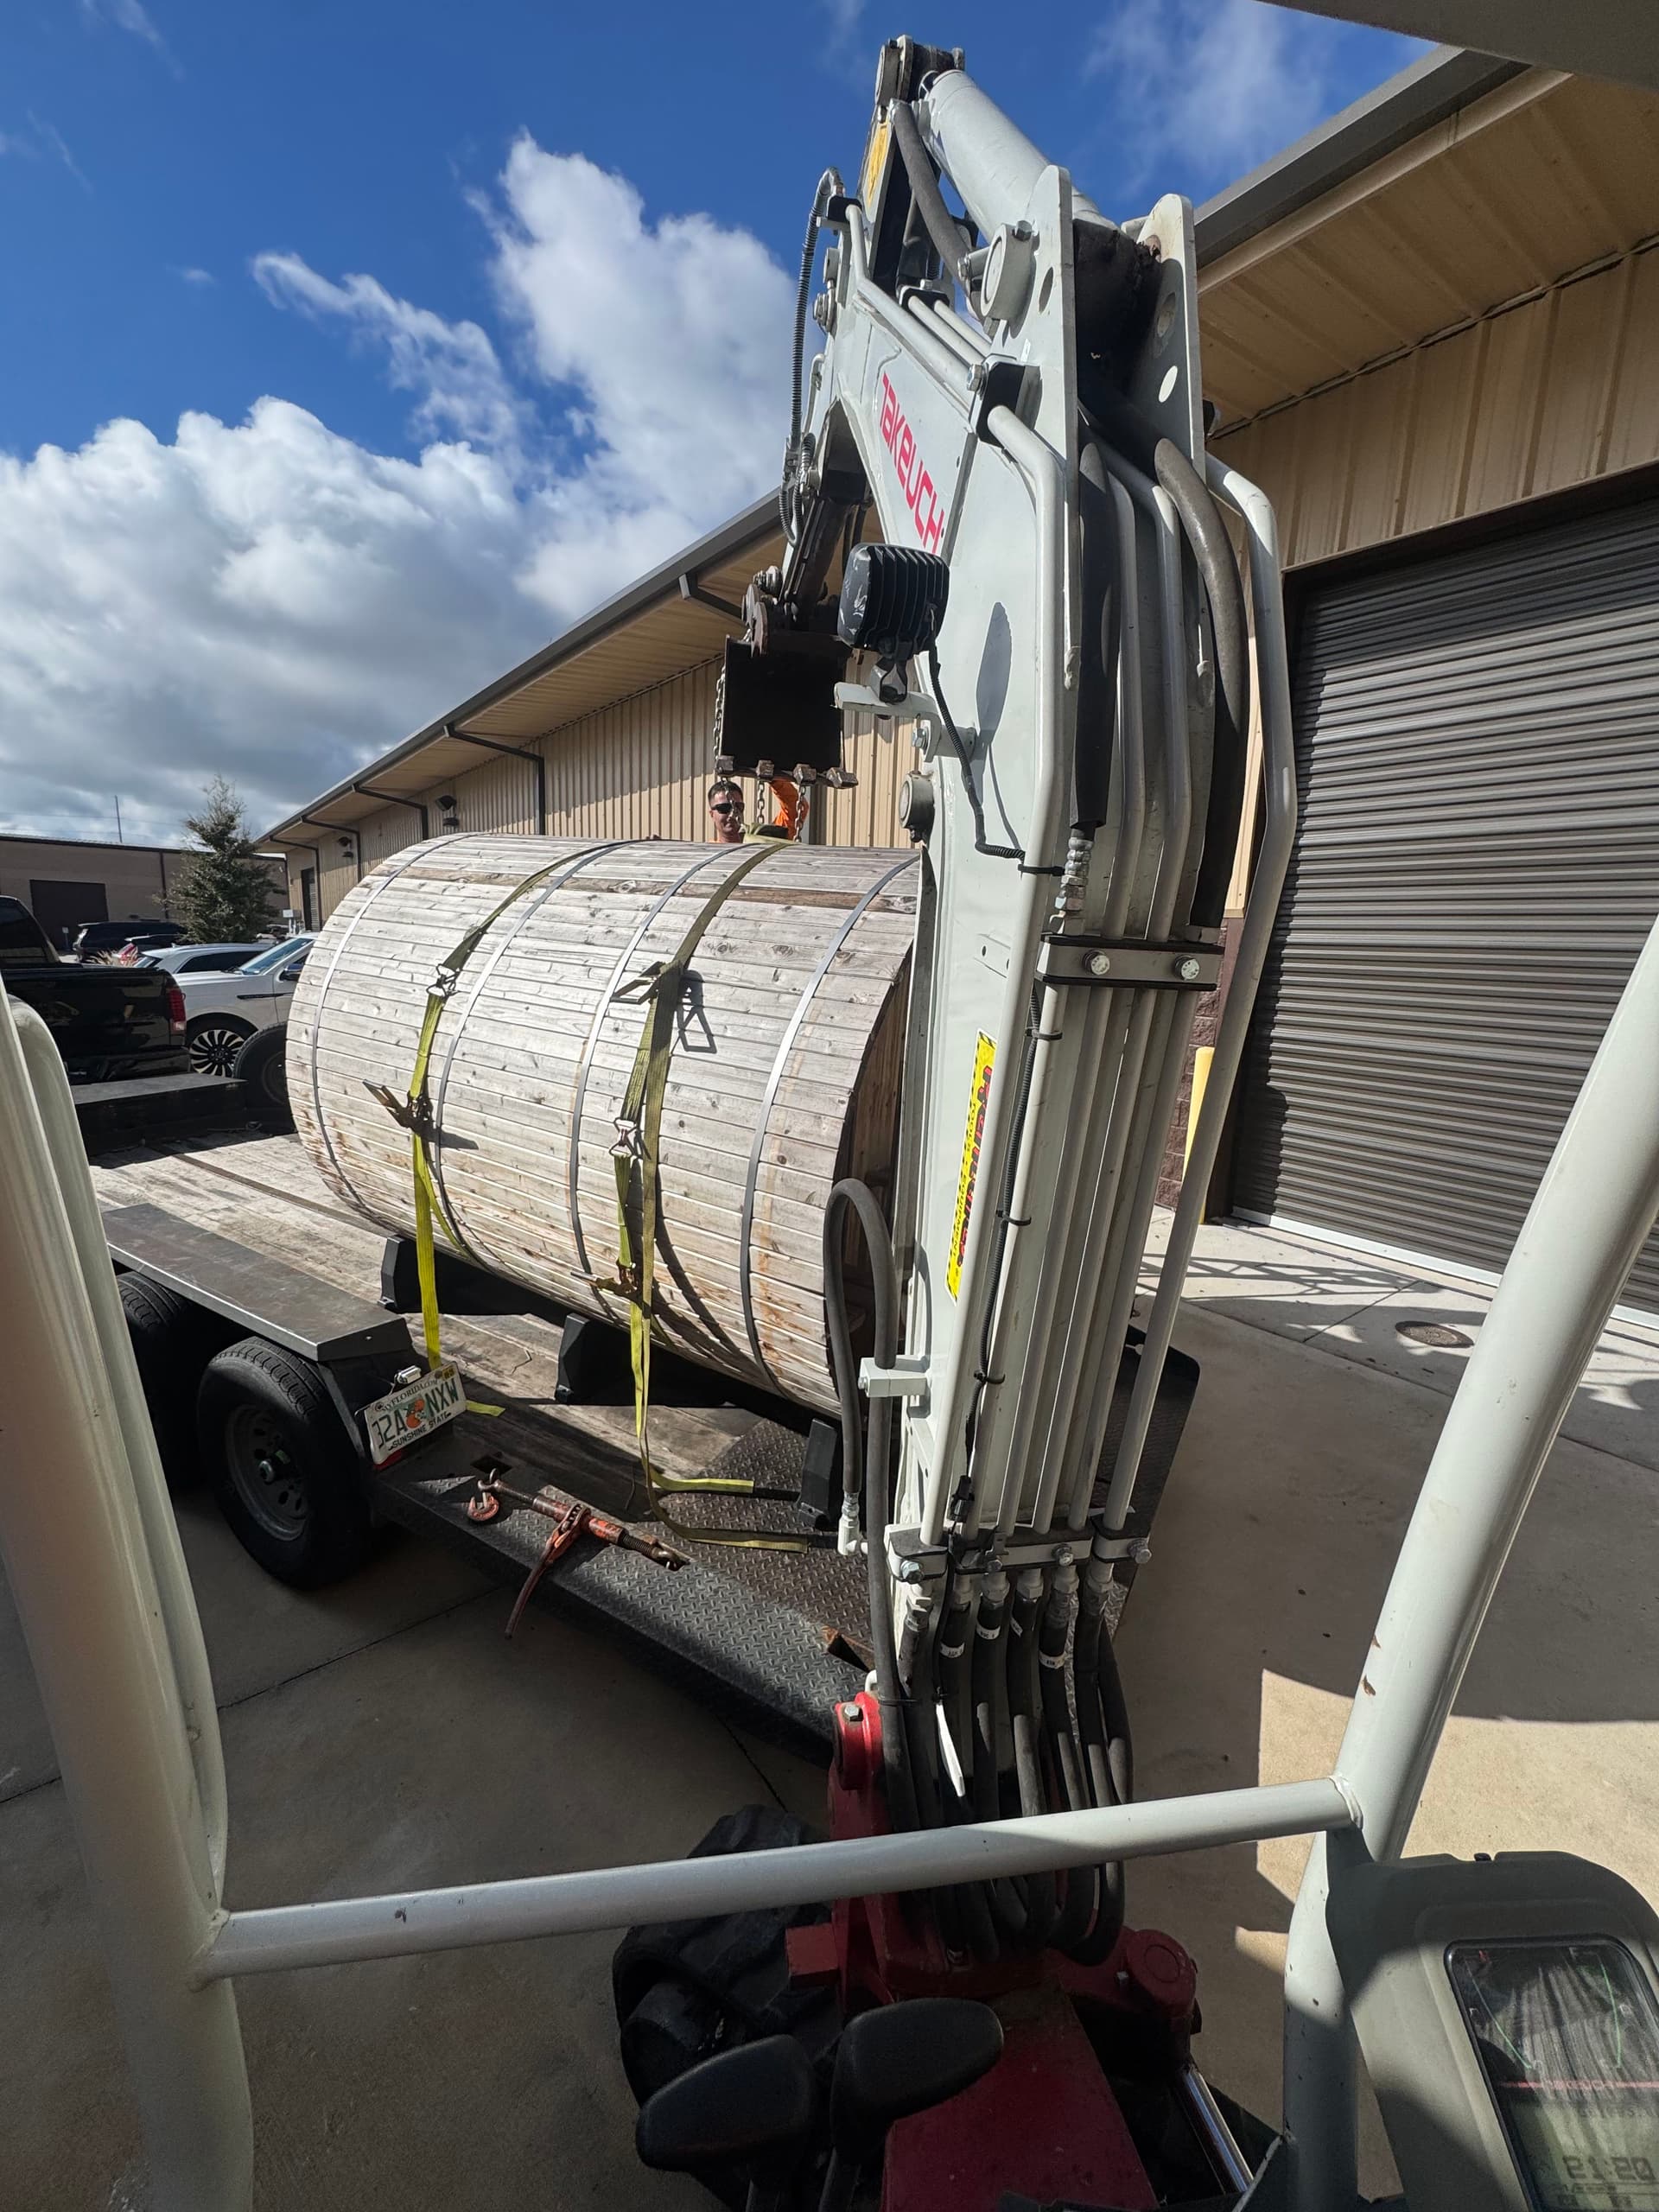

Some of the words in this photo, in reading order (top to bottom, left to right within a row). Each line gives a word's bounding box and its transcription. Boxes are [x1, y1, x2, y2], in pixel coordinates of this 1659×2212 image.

[880, 372, 944, 554] TAKEUCH
[966, 1102, 976, 1152] TOOLS
[952, 1174, 968, 1256] EQUIPMENT
[425, 1377, 460, 1416] NXW
[391, 1424, 427, 1449] SUNSHINE
[428, 1411, 448, 1430] STATE
